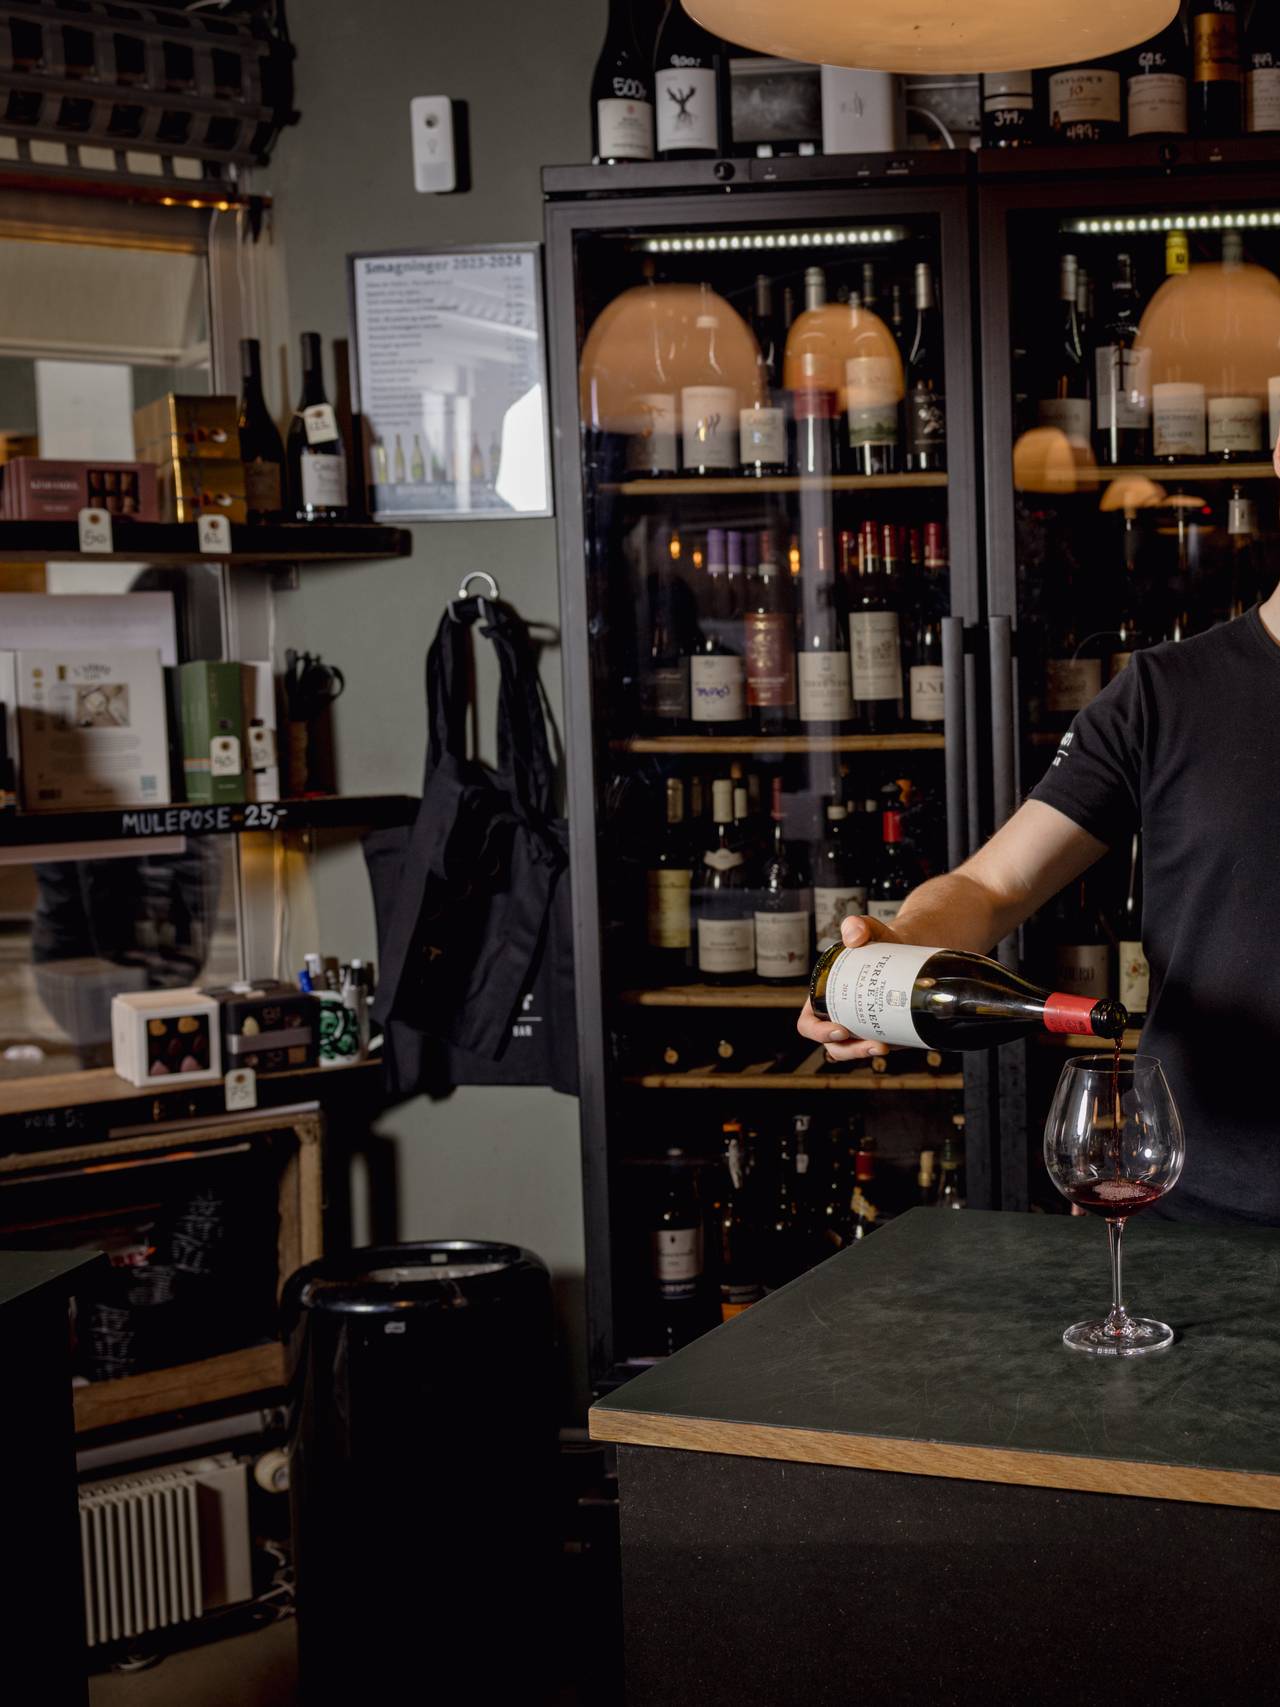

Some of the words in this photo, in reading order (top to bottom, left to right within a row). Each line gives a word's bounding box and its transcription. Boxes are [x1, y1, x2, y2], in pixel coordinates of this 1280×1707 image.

[364, 260, 449, 276] Smagninger
[453, 255, 522, 270] 2023-2024
[121, 806, 232, 835] MULEPOSE
[858, 963, 872, 991] ETNA
[867, 954, 892, 997] TERRE
[841, 983, 849, 1001] 2021
[857, 993, 867, 1025] ROSSO
